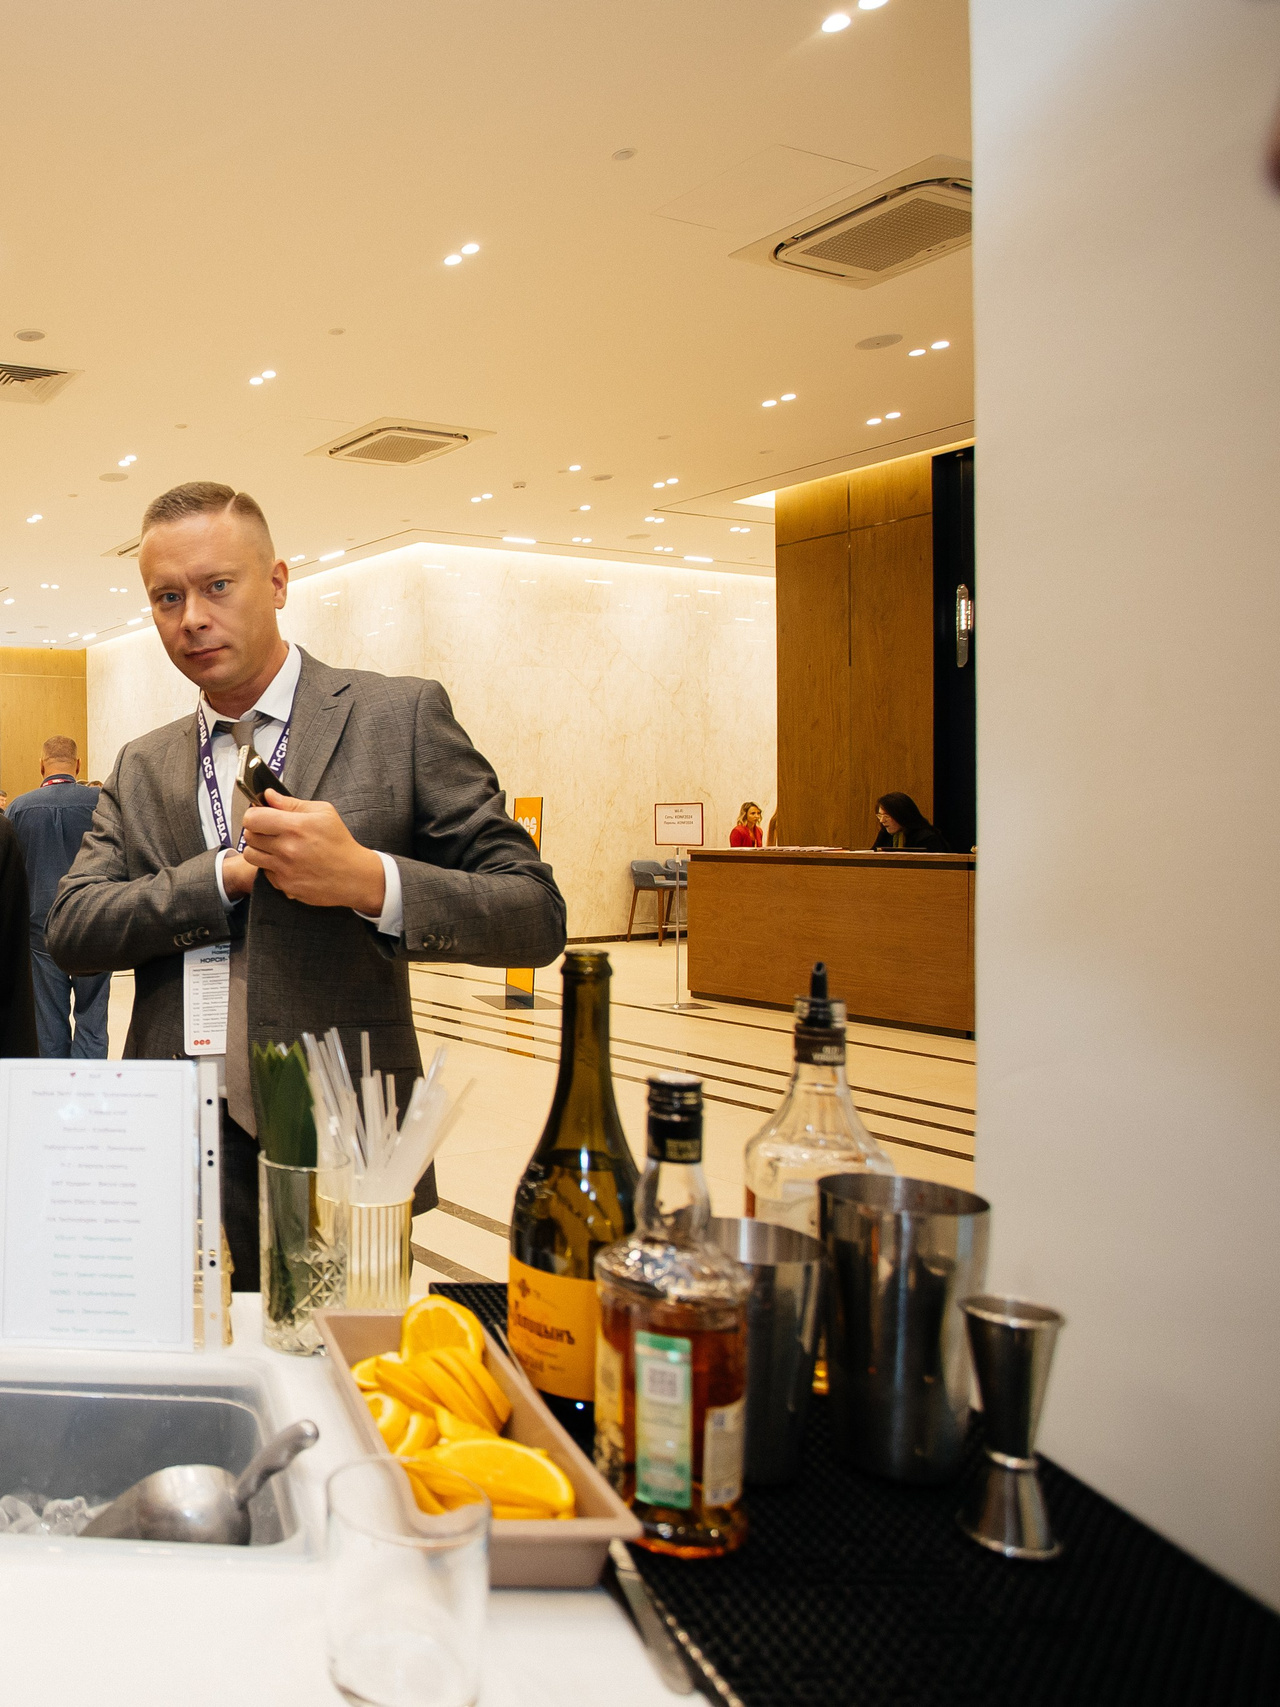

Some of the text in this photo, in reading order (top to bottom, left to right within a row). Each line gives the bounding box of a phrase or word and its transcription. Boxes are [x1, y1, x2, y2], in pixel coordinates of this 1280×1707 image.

[197, 704, 208, 747] СРЕДА
[202, 755, 214, 780] OCS
[210, 788, 228, 842] IT-СРЕДА
[200, 956, 228, 964] НОРСИ-
